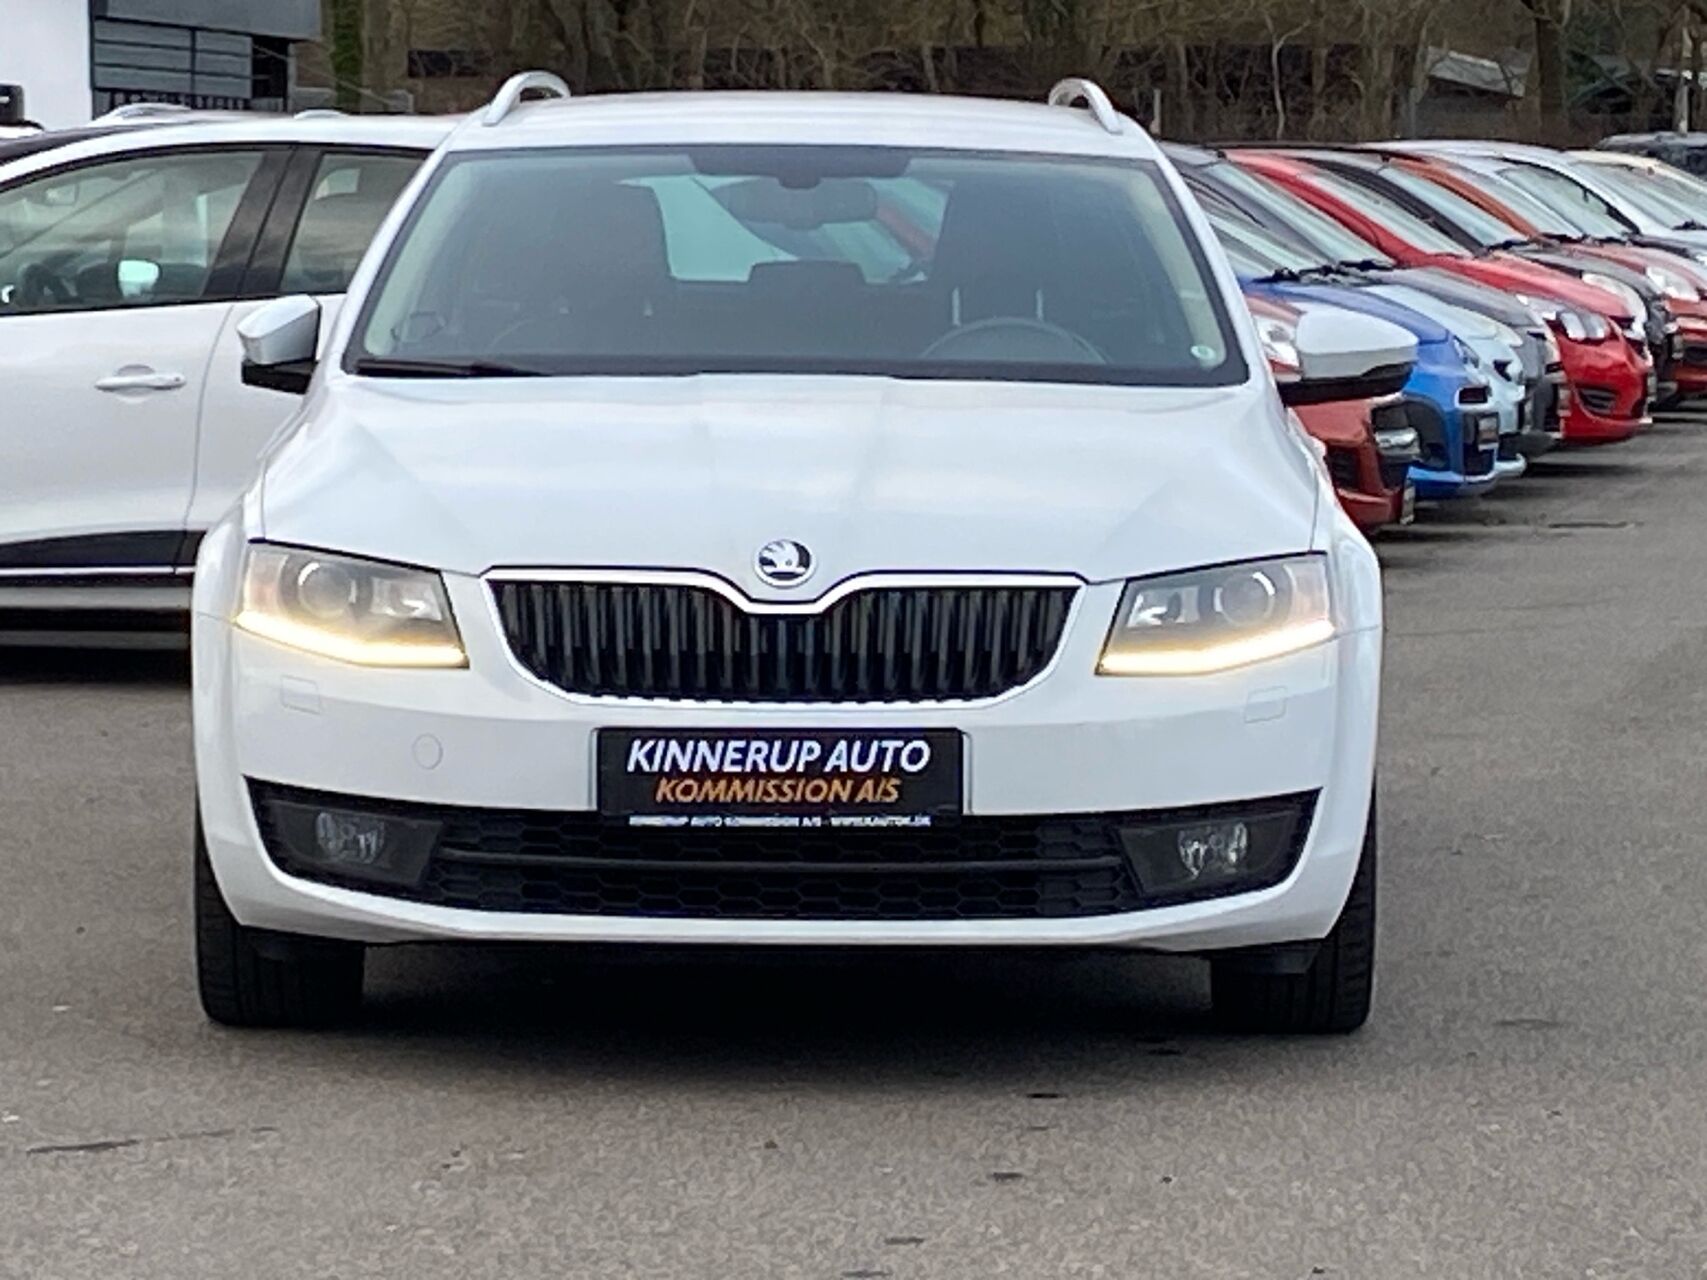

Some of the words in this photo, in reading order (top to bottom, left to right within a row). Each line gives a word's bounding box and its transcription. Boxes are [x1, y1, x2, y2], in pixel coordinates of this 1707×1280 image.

[627, 739, 821, 773] KINNERUP
[823, 739, 931, 773] AUTO
[655, 777, 854, 803] KOMMISSION
[854, 777, 902, 803] A/S
